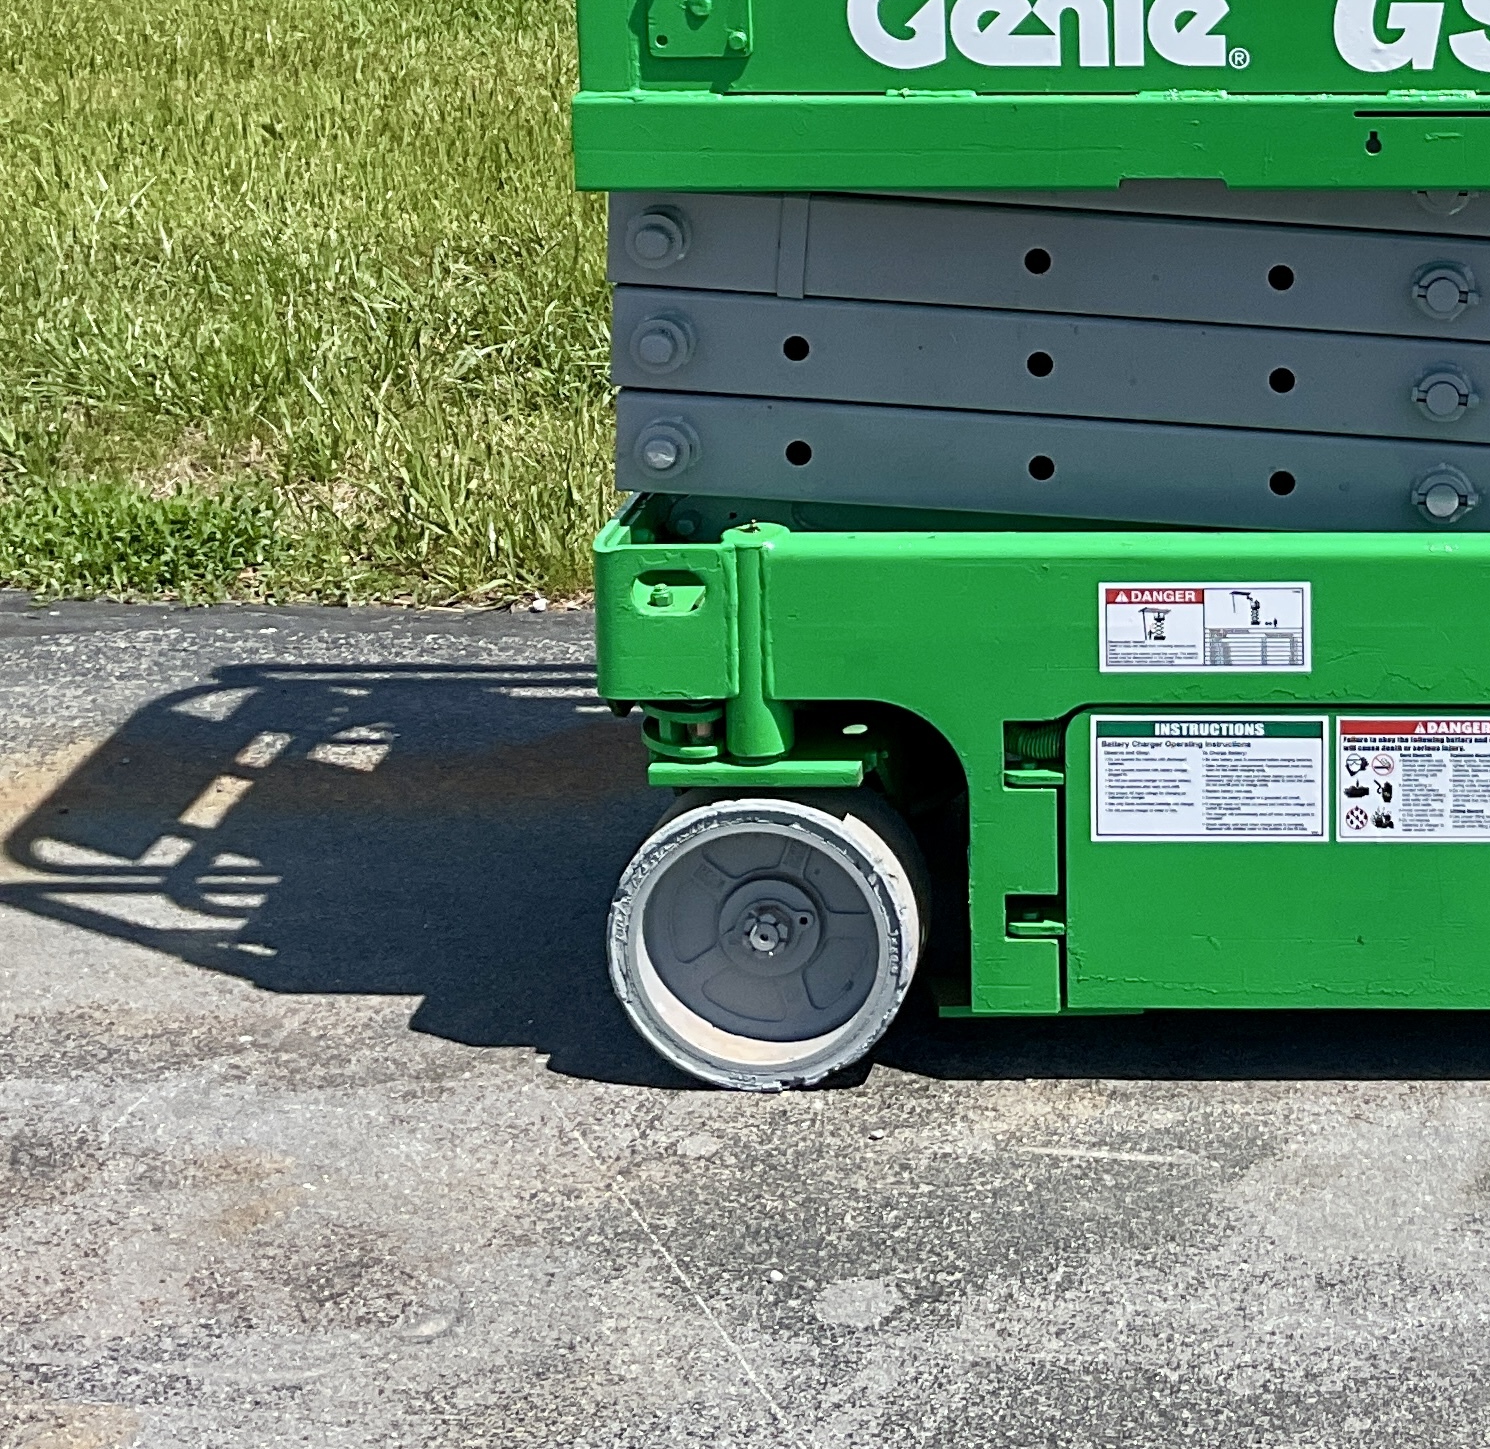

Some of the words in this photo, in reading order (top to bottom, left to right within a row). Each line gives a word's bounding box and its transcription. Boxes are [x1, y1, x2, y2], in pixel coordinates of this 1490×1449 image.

[1130, 590, 1196, 603] DANGER
[1154, 722, 1265, 736] INSTRUCTIONS
[1101, 740, 1130, 749] Battery
[1131, 740, 1162, 749] Charger
[1165, 740, 1203, 749] Operating
[1205, 740, 1252, 748] Instructions
